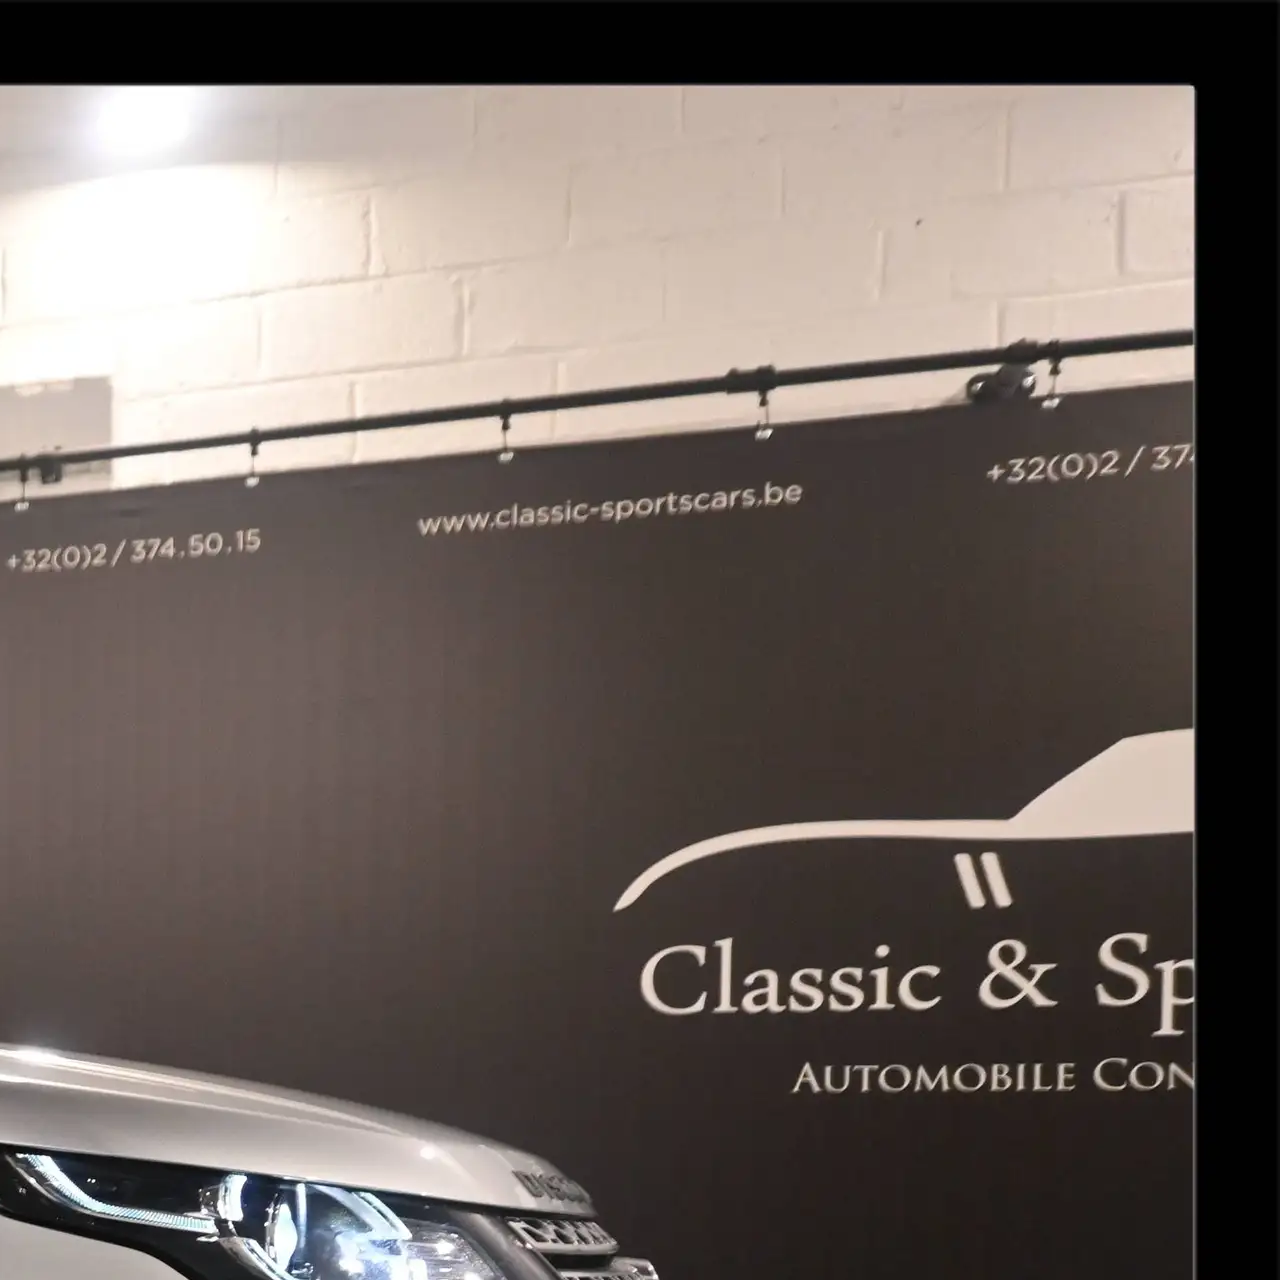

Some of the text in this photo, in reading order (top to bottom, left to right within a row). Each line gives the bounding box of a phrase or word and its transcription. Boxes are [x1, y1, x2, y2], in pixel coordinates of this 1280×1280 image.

[1150, 443, 1195, 472] 37
[417, 482, 805, 537] www.classic-sportscars.be
[130, 528, 263, 564] 374.50.15
[640, 932, 1195, 1038] Classic & Sp
[791, 1061, 1077, 1095] AUTOMOBILE
